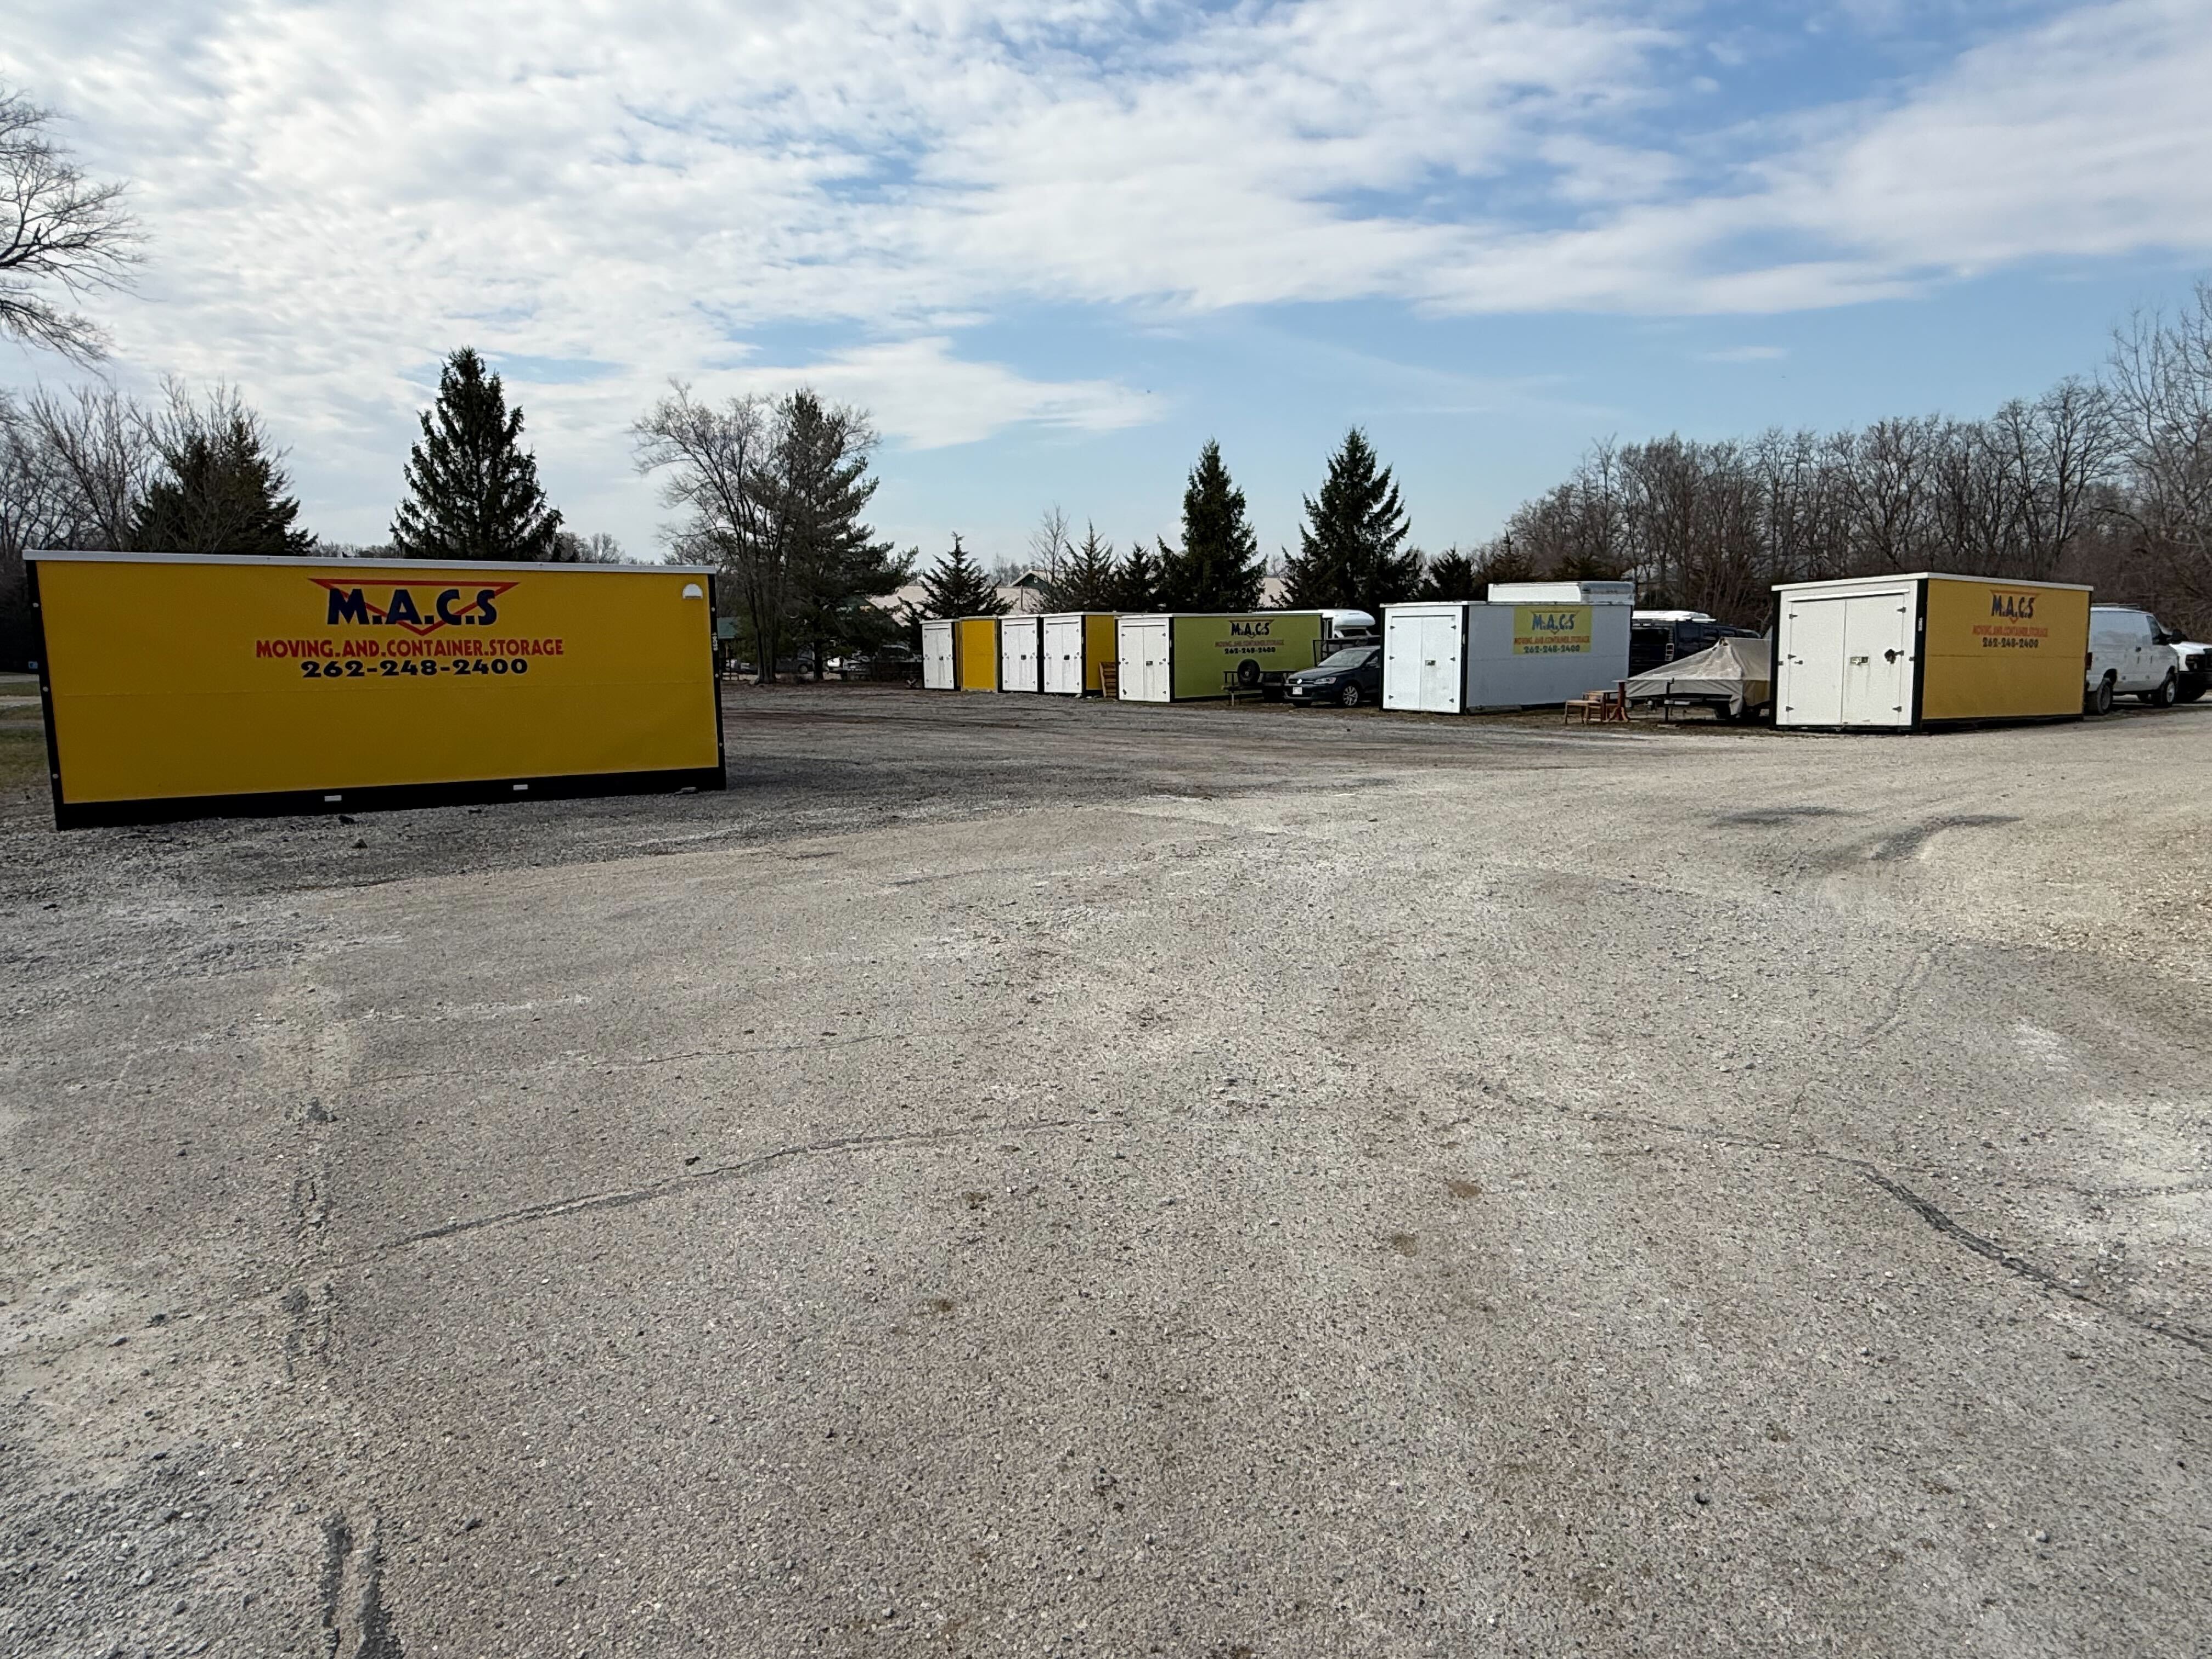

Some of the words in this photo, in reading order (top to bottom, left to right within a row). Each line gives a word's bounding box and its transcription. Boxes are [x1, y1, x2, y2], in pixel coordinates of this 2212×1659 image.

[327, 588, 498, 625] M.A.C.S
[1991, 595, 2035, 618] M.A.C.S
[1231, 622, 1270, 636] M.A.C.S
[1532, 613, 1576, 630] M.A.C.S
[301, 658, 528, 678] 262-248-2400
